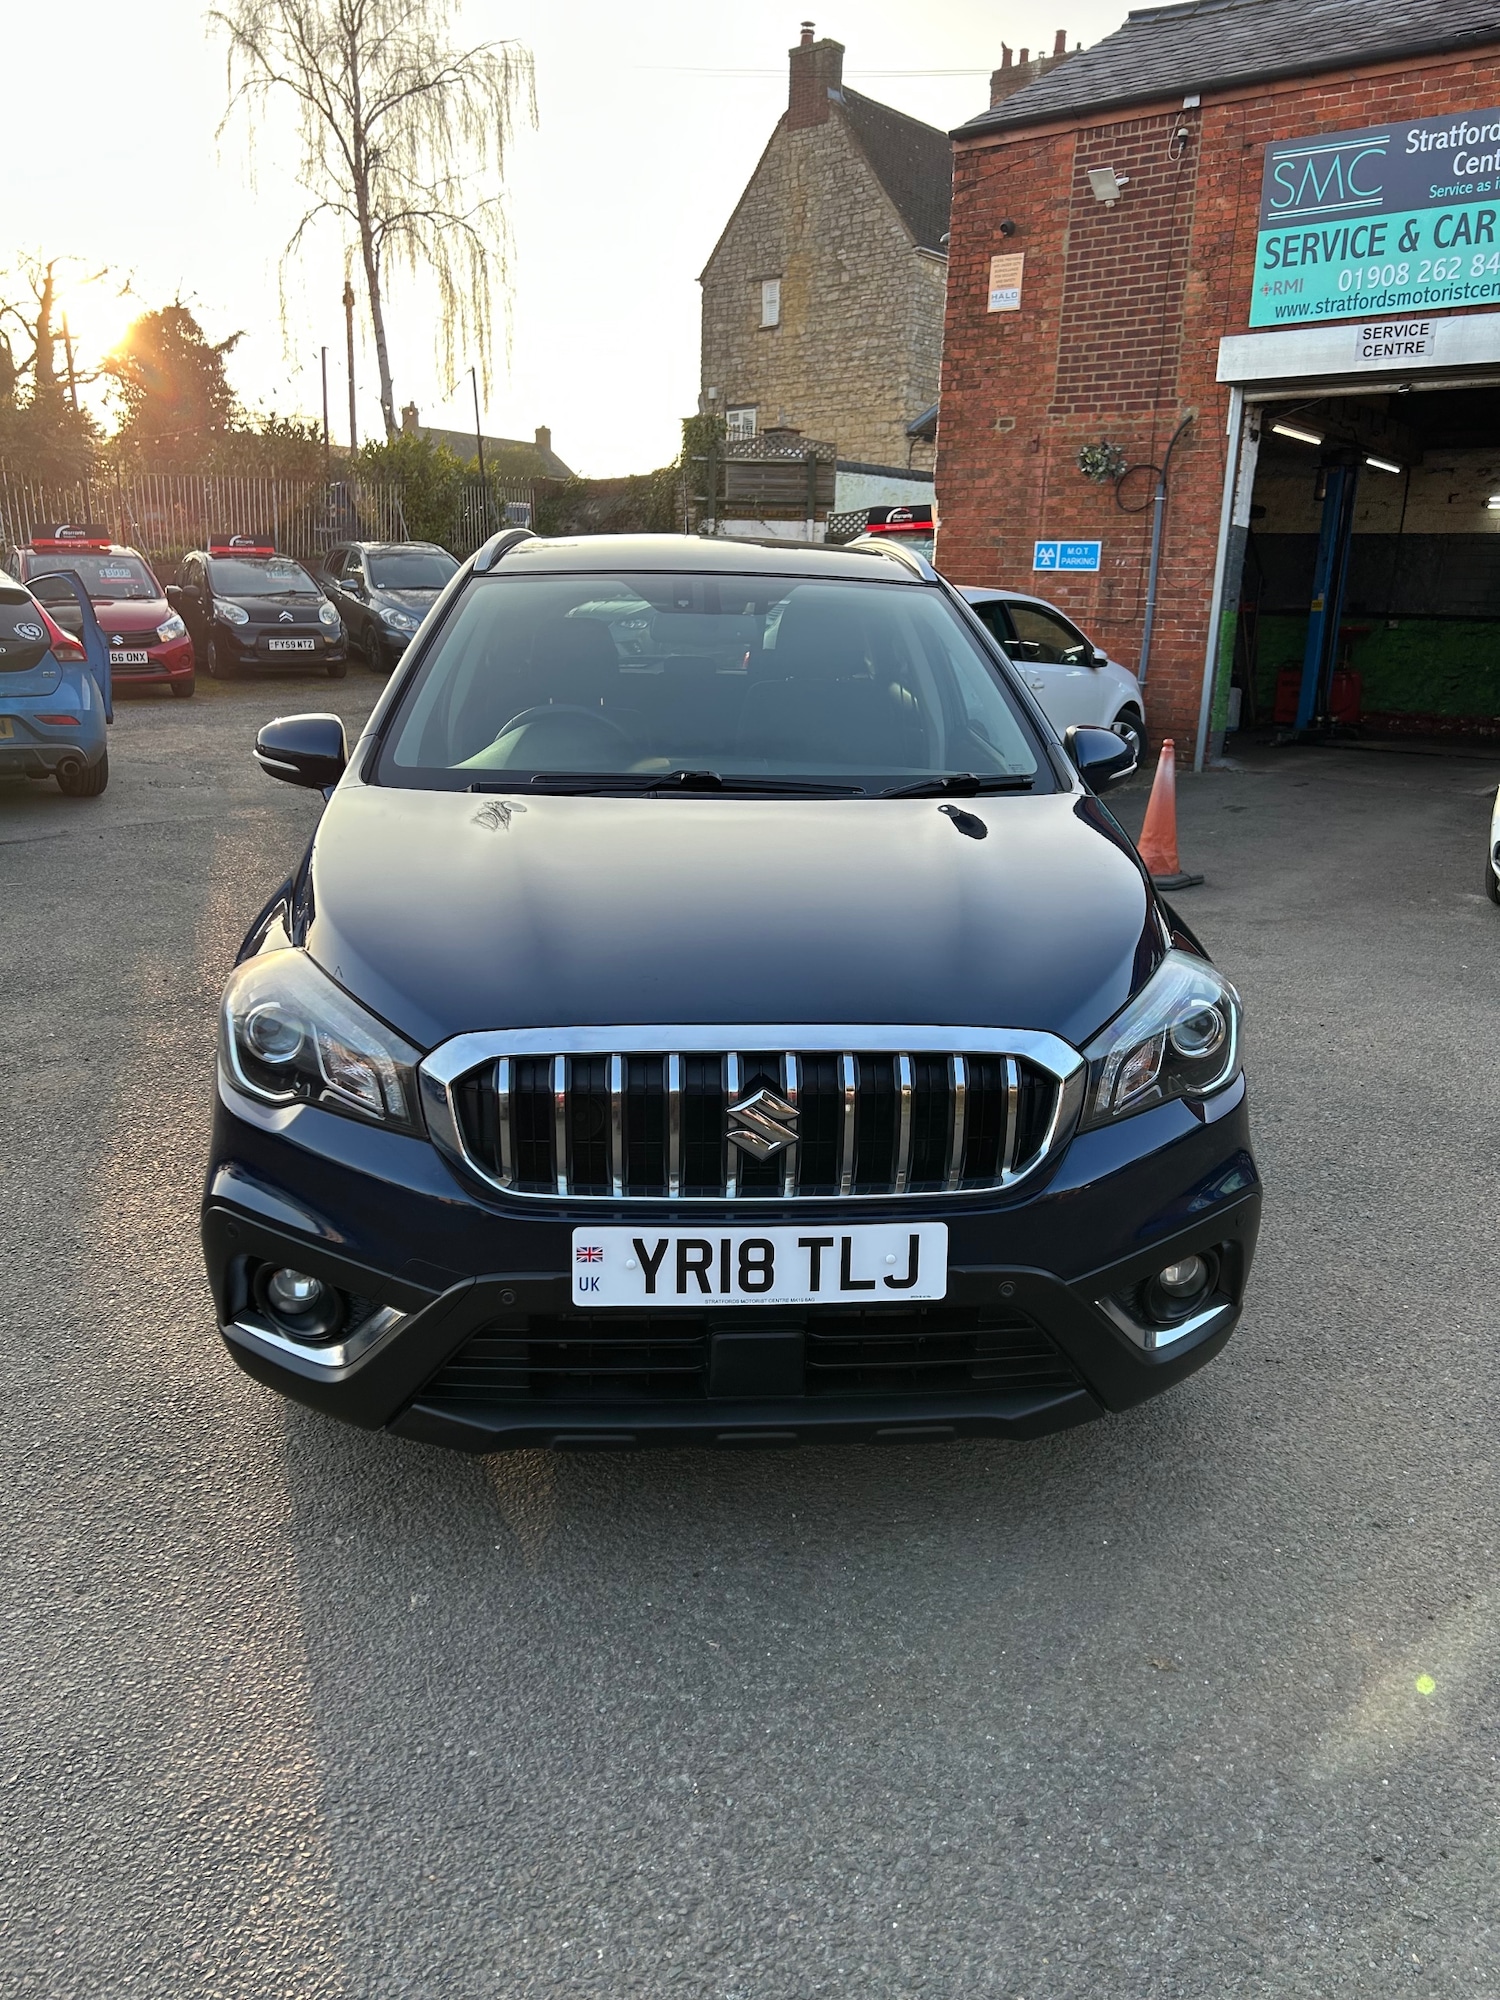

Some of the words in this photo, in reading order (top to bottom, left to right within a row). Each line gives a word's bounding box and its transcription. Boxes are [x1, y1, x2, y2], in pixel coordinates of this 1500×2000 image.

[1270, 148, 1387, 208] SMC
[1429, 182, 1473, 198] Service
[1476, 180, 1492, 192] as
[1263, 222, 1388, 270] SERVICE
[1398, 218, 1421, 253] &
[1433, 209, 1497, 248] CAR
[1338, 262, 1409, 292] 01908
[1417, 256, 1462, 283] 262
[1469, 251, 1500, 277] 84
[991, 291, 1018, 300] HALO
[1273, 278, 1304, 296] RMI
[1362, 322, 1430, 340] SERVICE
[1362, 340, 1426, 358] CENTRE
[1060, 557, 1096, 566] PARKING
[274, 640, 296, 649] FY59
[126, 652, 146, 662] ONX
[632, 1238, 776, 1294] YR18
[798, 1234, 920, 1292] TLJ
[579, 1276, 600, 1292] UK
